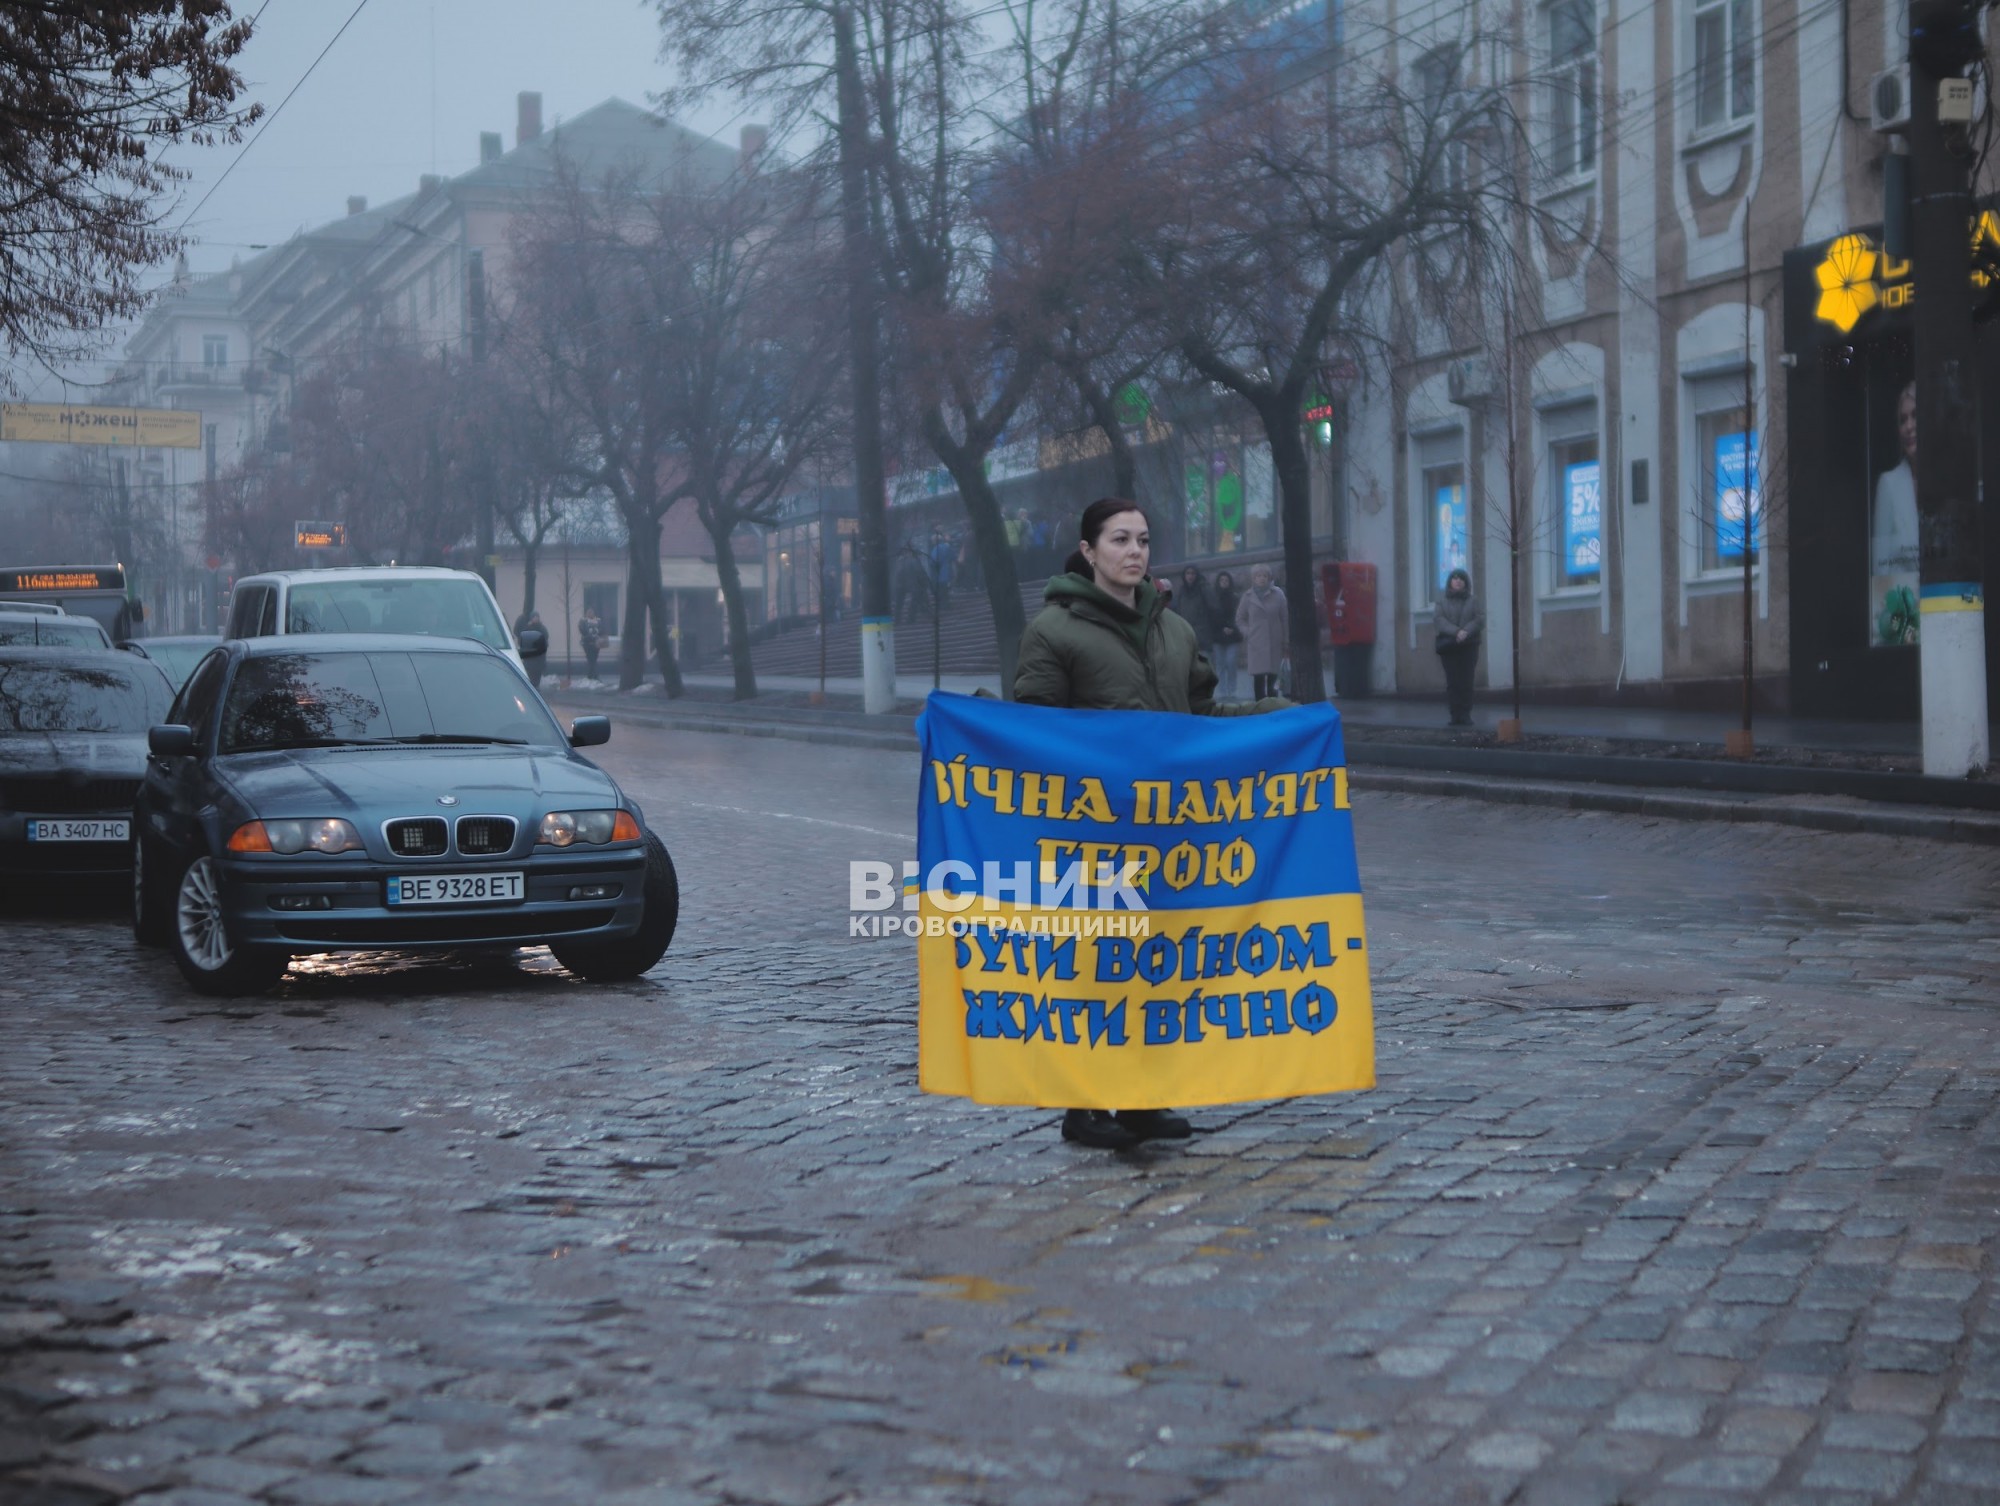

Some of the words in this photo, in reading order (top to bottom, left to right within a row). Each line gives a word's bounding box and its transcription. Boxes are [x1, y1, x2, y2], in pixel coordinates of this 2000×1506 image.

[38, 823, 60, 838] BA
[64, 823, 99, 838] 3407
[103, 823, 124, 838] HC
[1036, 835, 1256, 891] ГЕРОЮ
[401, 880, 432, 900] BE
[436, 878, 486, 899] 9328
[490, 876, 520, 897] ET
[962, 989, 1129, 1050] ЖИТИ
[1144, 980, 1338, 1047] ВІЧНО
